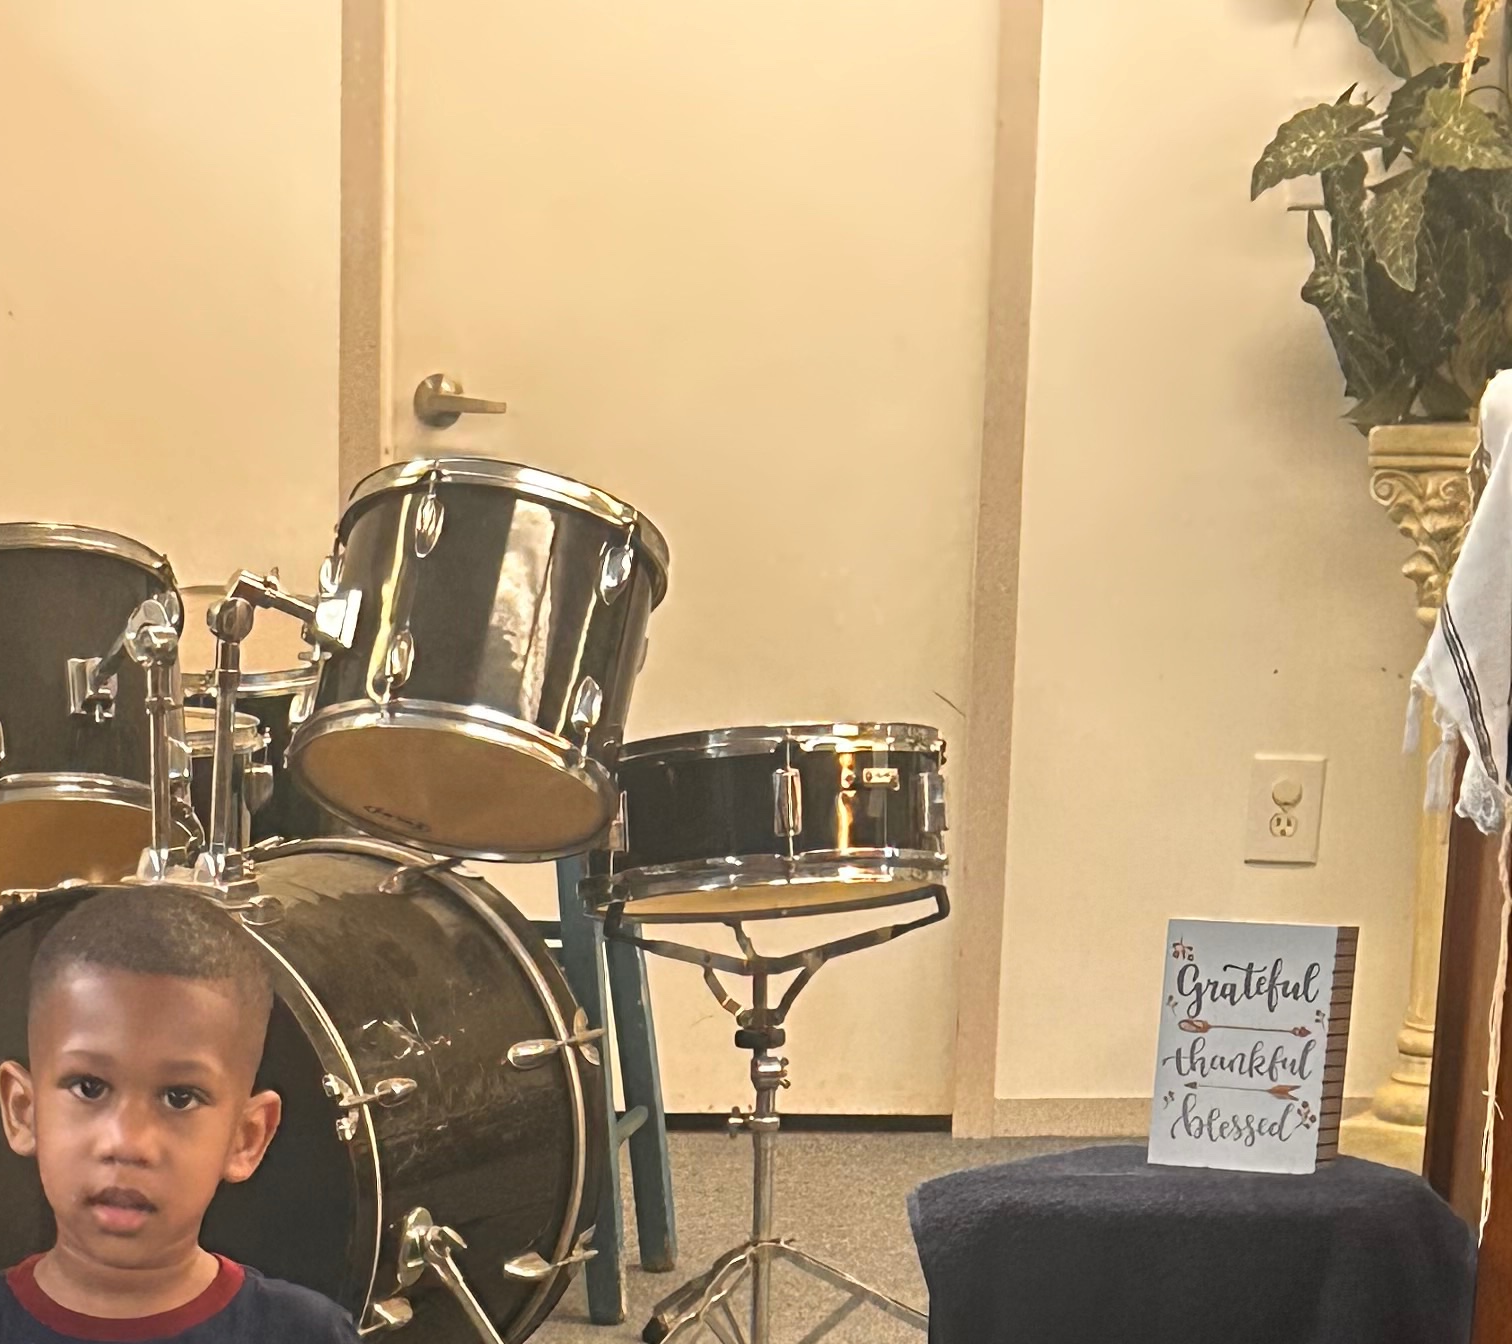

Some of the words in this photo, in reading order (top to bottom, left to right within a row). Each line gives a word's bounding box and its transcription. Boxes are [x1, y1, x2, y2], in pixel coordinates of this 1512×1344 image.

[1176, 958, 1321, 1018] Grateful
[1162, 1036, 1317, 1082] thankful
[1170, 1093, 1295, 1147] blessed
